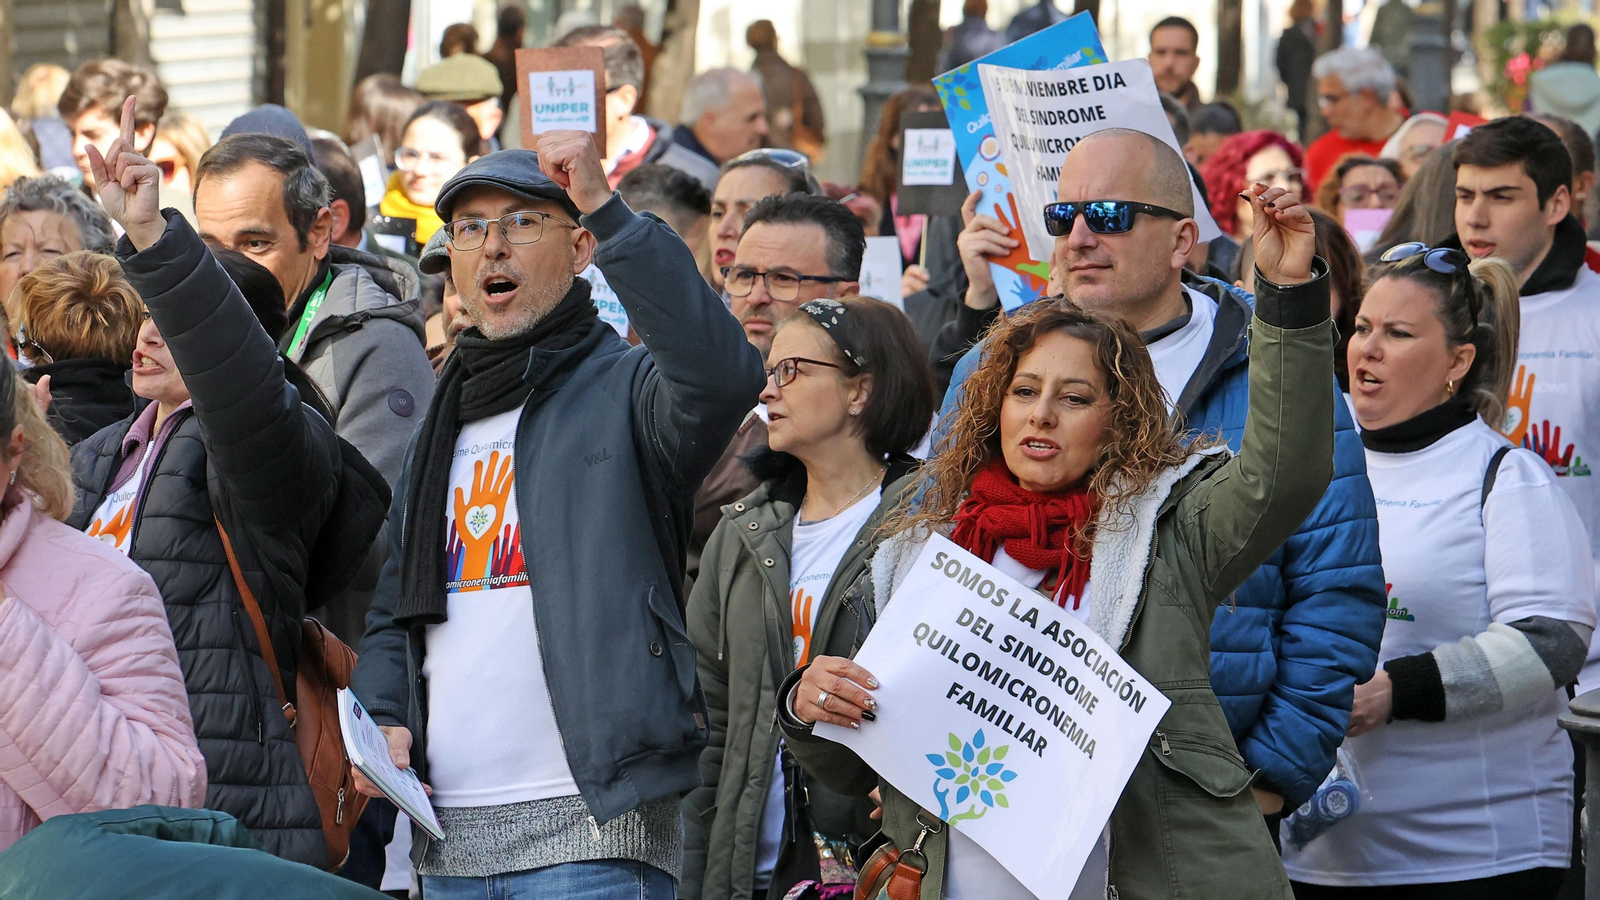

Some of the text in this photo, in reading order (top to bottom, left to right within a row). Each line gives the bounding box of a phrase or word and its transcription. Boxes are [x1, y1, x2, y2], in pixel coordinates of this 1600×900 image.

[1092, 72, 1127, 91] DIA
[534, 102, 589, 114] UNIPER
[1015, 105, 1107, 126] DEL SINDROME
[594, 299, 626, 316] IPER
[930, 551, 1147, 713] SOMOS LA ASOCIACIÓN
[955, 607, 1099, 715] DEL SINDROME
[913, 622, 1097, 760] QUILOMICRONEMIA
[946, 682, 1048, 757] FAMILIAR
